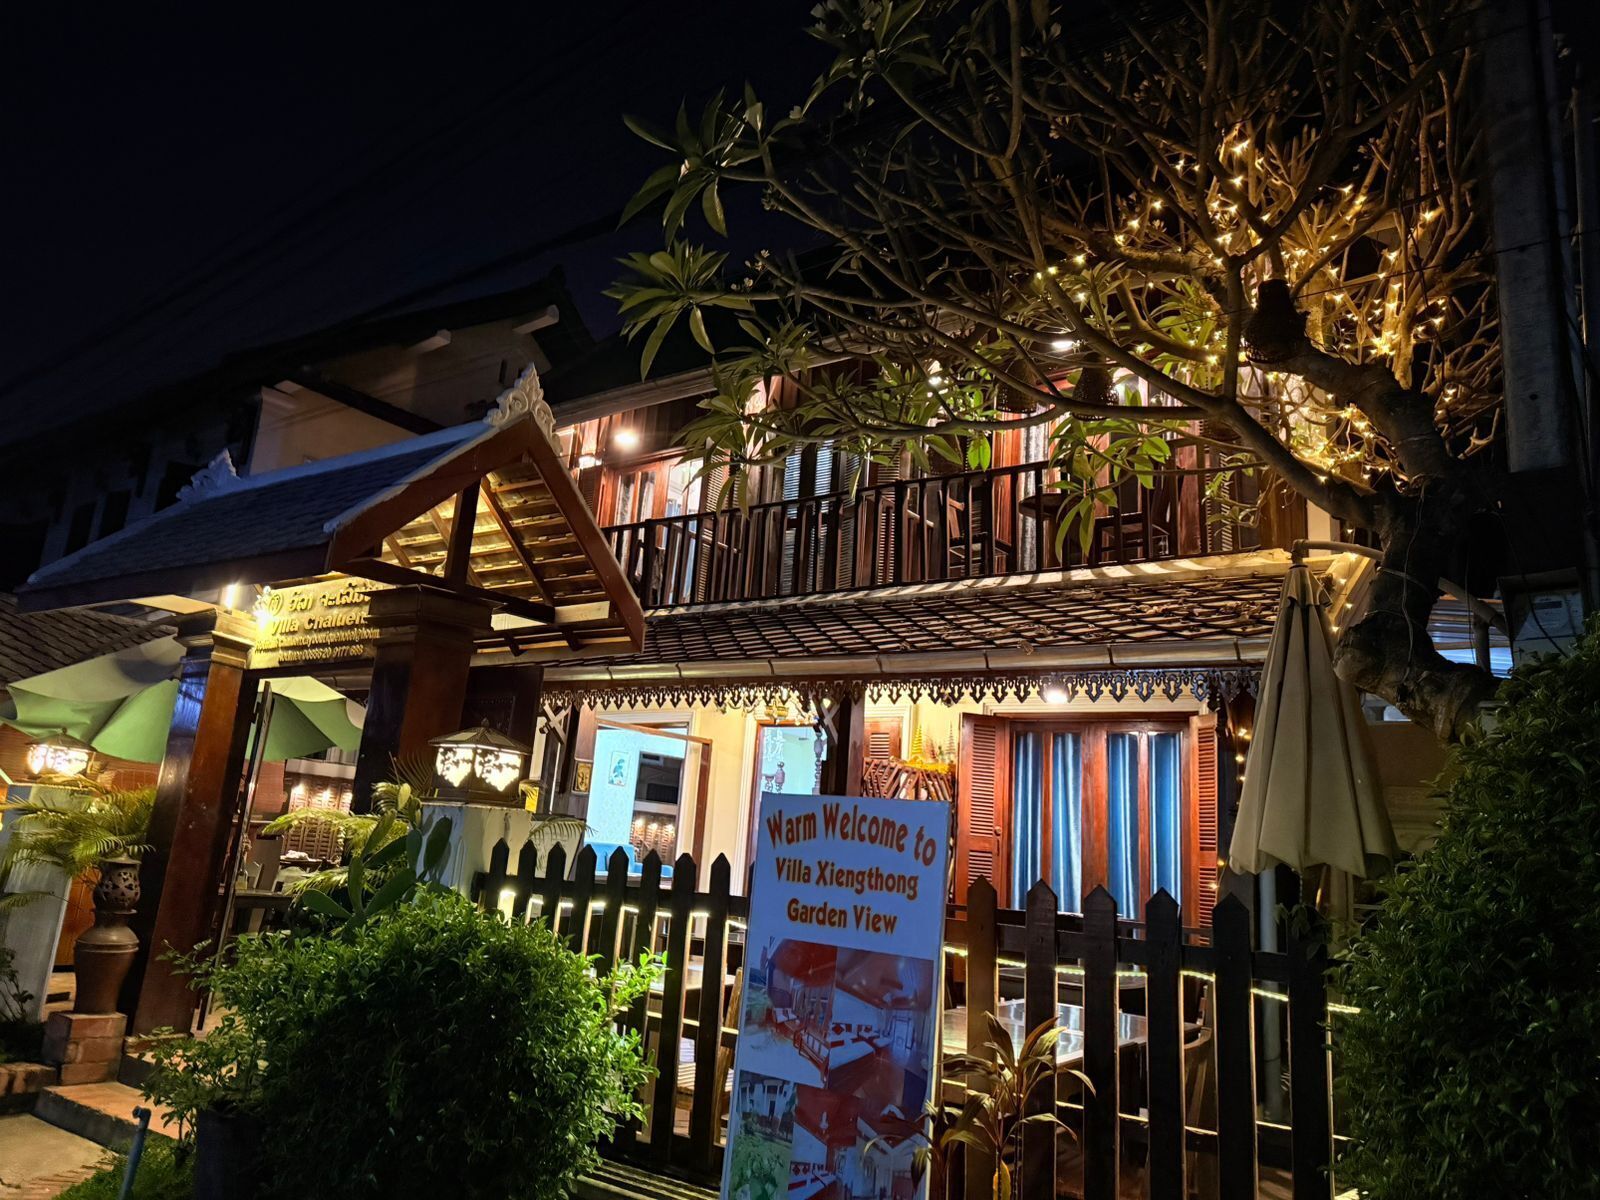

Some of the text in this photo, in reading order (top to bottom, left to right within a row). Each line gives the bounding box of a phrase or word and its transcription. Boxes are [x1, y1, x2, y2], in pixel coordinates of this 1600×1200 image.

[271, 614, 299, 635] Villa
[767, 803, 937, 867] Warm Welcome to
[775, 857, 919, 901] Villa Xiengthong
[787, 898, 898, 935] Garden View
